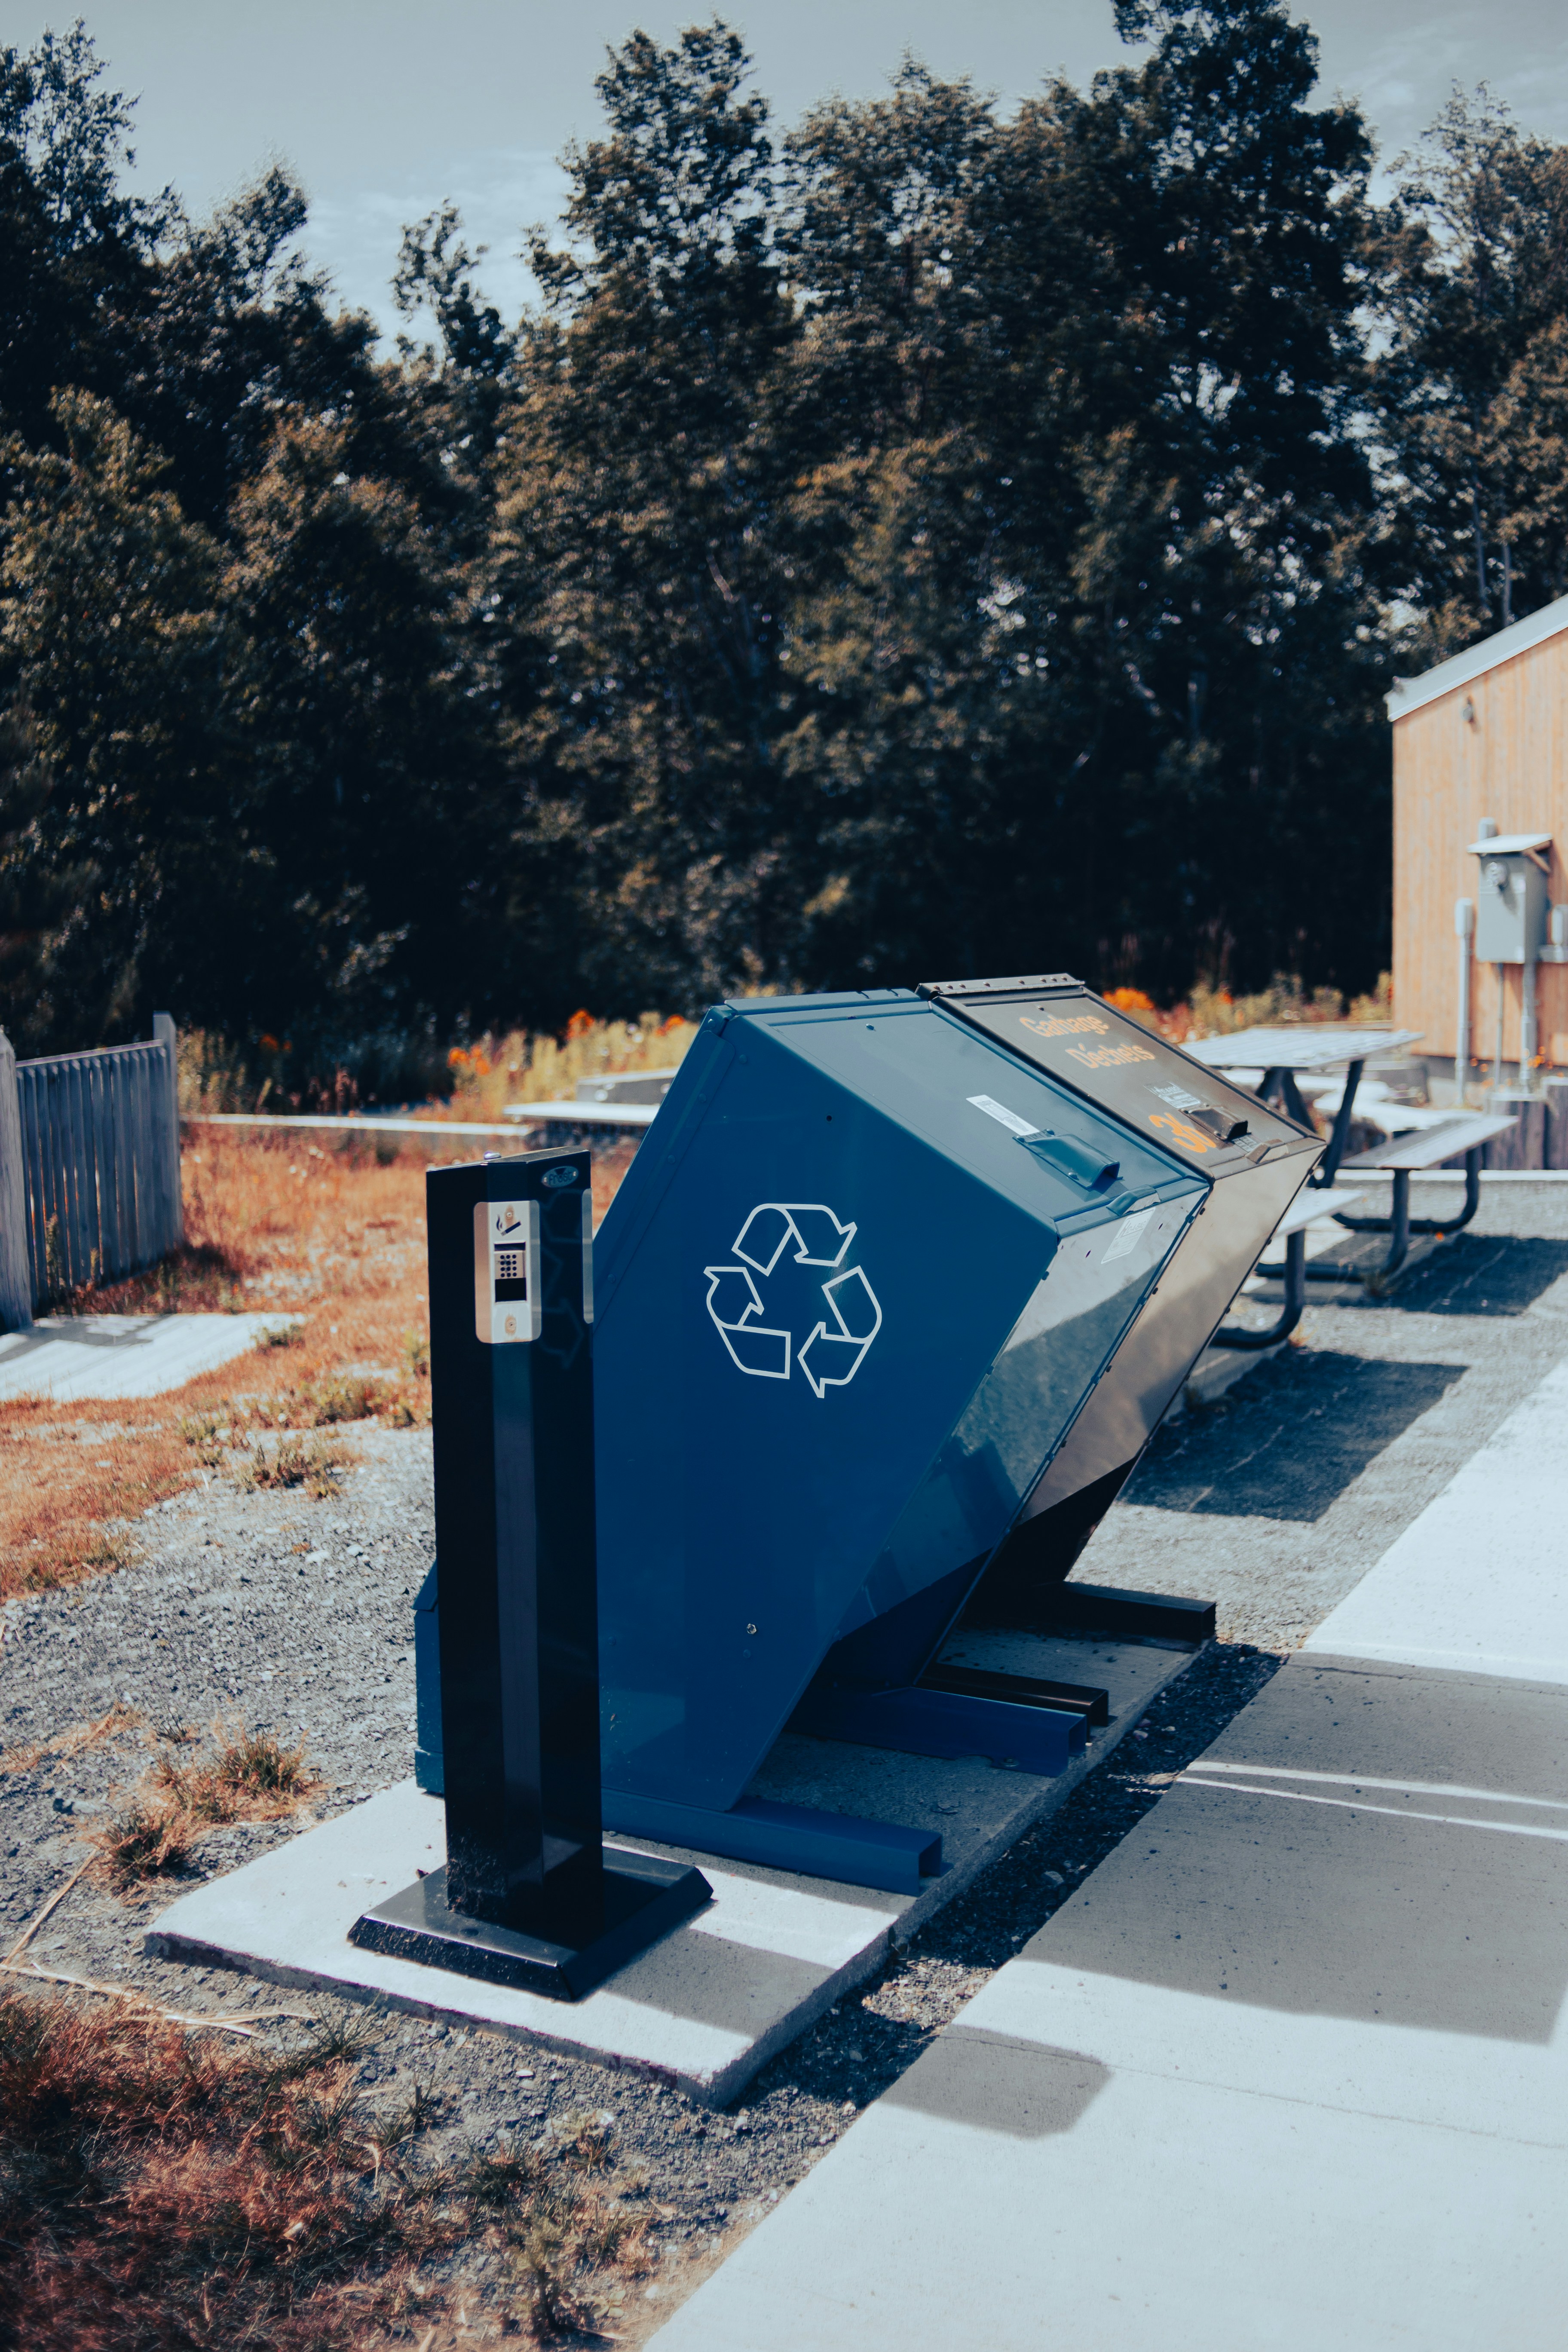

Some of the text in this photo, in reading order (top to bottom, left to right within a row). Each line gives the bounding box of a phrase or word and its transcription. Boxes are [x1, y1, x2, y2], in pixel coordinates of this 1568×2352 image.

[1019, 1014, 1110, 1037] Garbage
[1065, 1043, 1156, 1069] Déchets
[1148, 1112, 1216, 1153] 36
